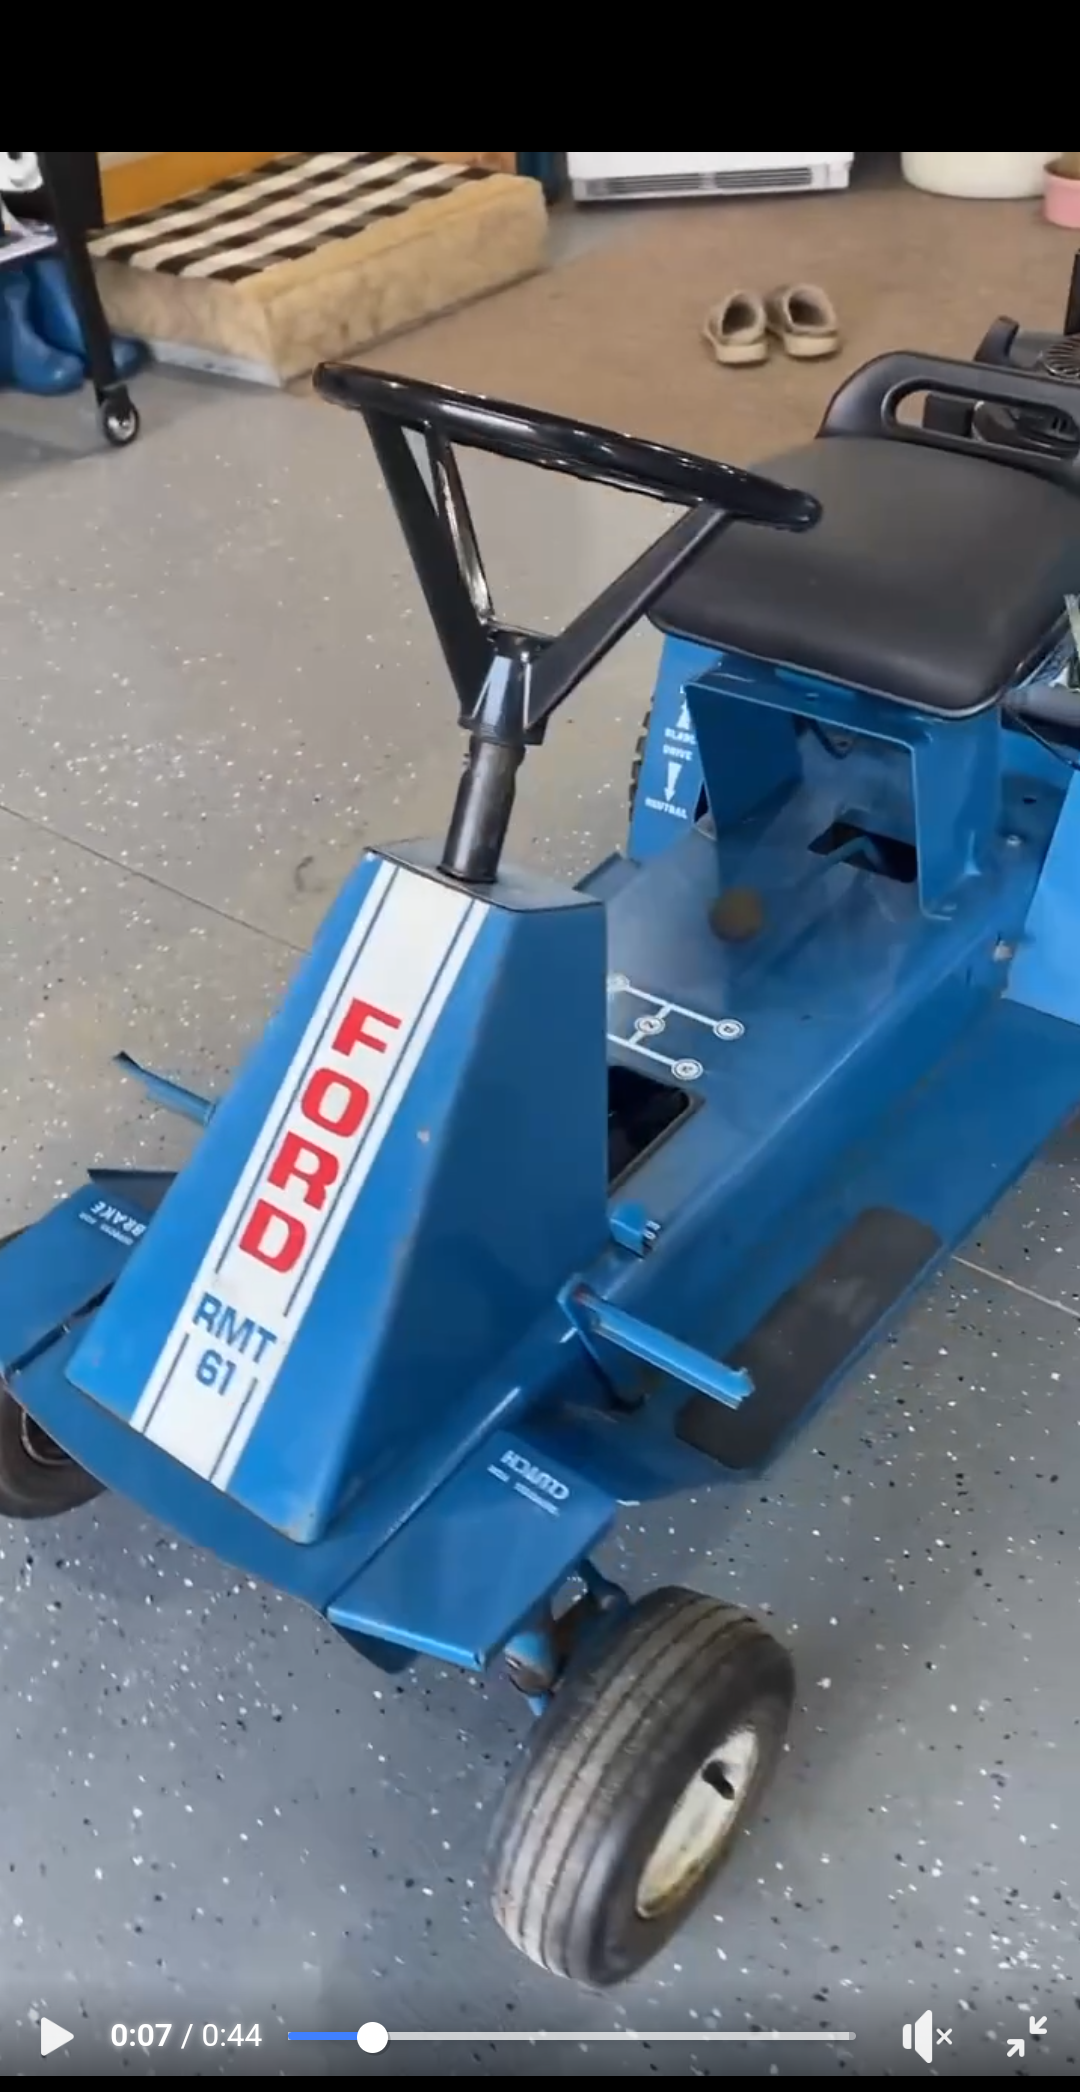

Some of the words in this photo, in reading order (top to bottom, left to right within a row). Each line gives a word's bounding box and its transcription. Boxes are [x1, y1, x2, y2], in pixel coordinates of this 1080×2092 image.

[239, 997, 402, 1273] FORD
[90, 1201, 146, 1236] BRAKE
[192, 1291, 277, 1364] RMT
[195, 1348, 237, 1396] 61
[500, 1450, 569, 1499] CLUTCH
